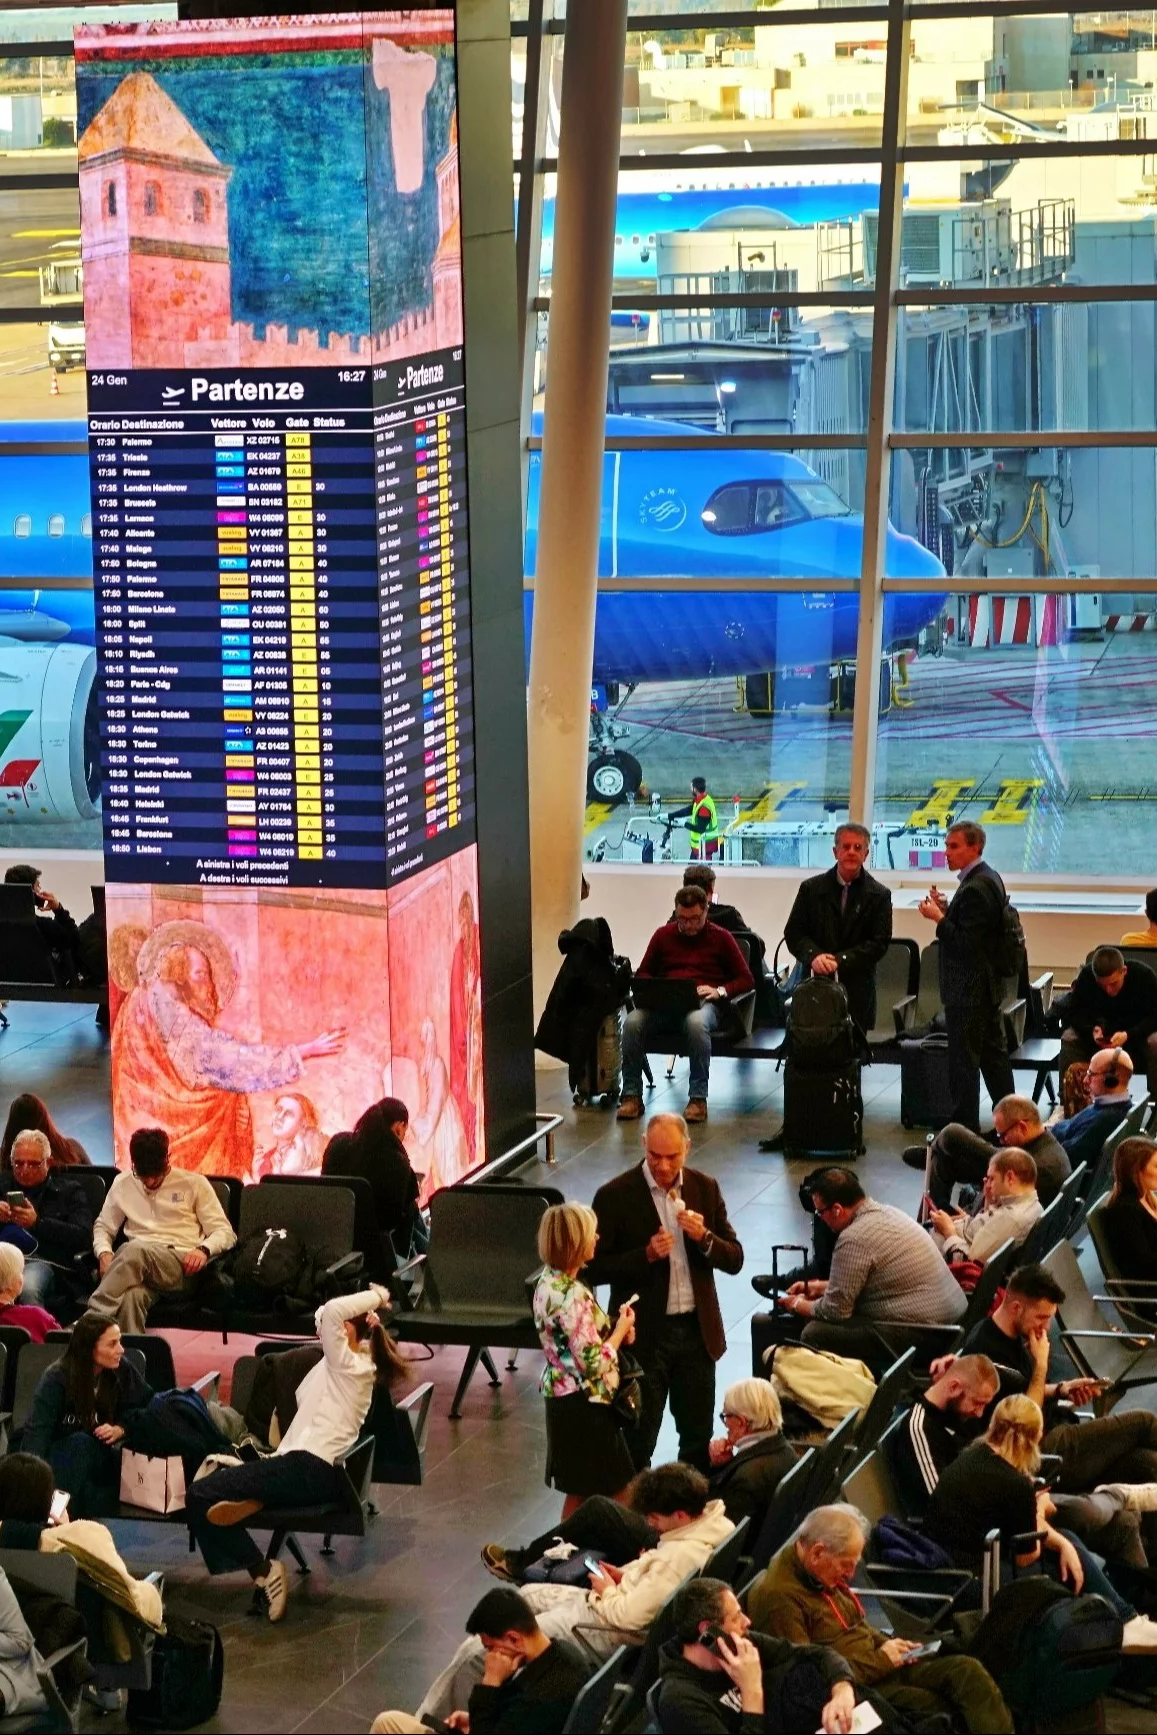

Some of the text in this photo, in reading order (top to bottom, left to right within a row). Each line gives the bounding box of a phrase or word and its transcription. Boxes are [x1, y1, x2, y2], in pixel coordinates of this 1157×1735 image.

[91, 374, 128, 386] 24 Gen
[337, 370, 366, 383] 16:27
[406, 363, 444, 390] Partenze
[191, 377, 305, 402] Partenze
[89, 416, 346, 431] Orario Destinazione Vettore Volo Gate Status
[638, 487, 677, 525] SKYTEAM
[195, 858, 290, 872] A sinistra i voli precedenti
[199, 872, 289, 885] A destra i voli successivi
